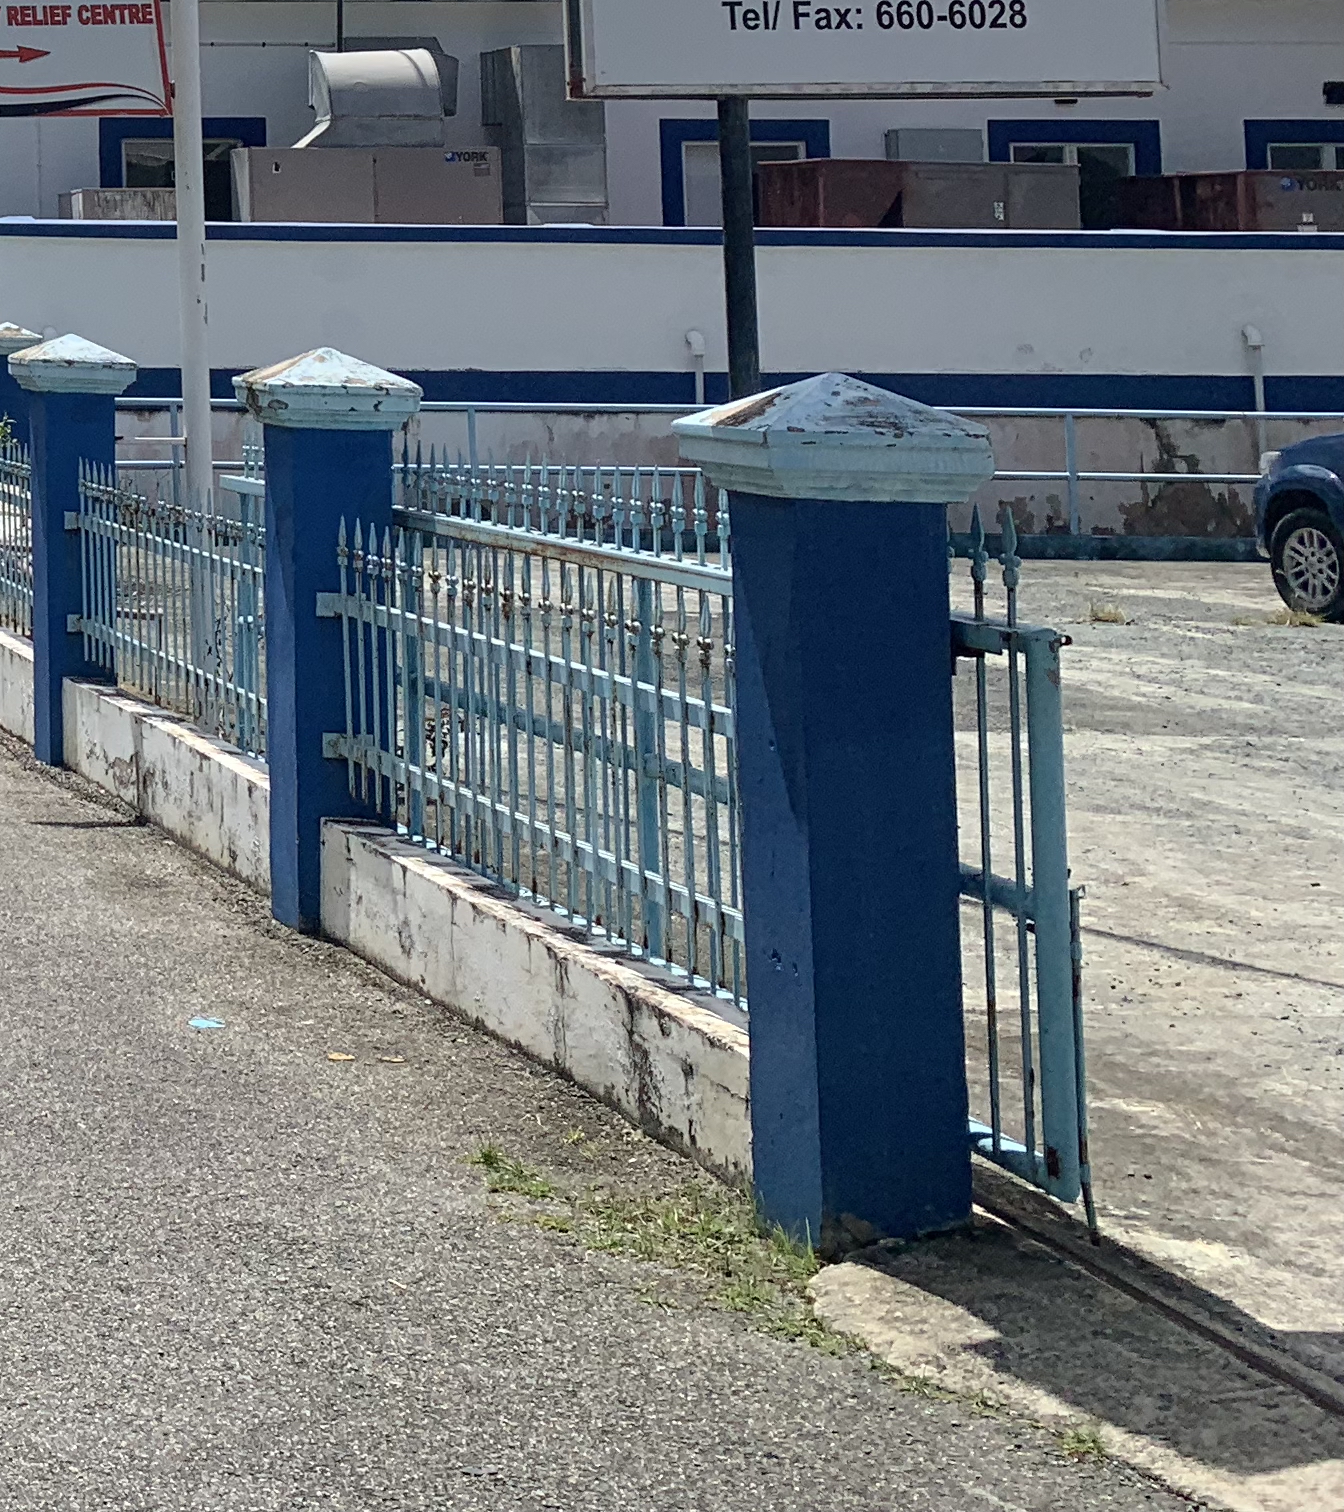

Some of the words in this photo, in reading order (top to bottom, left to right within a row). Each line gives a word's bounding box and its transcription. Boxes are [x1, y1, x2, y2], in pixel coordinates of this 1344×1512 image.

[6, 5, 72, 26] RELIEF
[77, 3, 154, 25] CENTRE
[722, 0, 780, 30] Tel/
[794, 0, 863, 30] Fax:
[875, 0, 1028, 30] 660-6028
[456, 151, 489, 162] YORK
